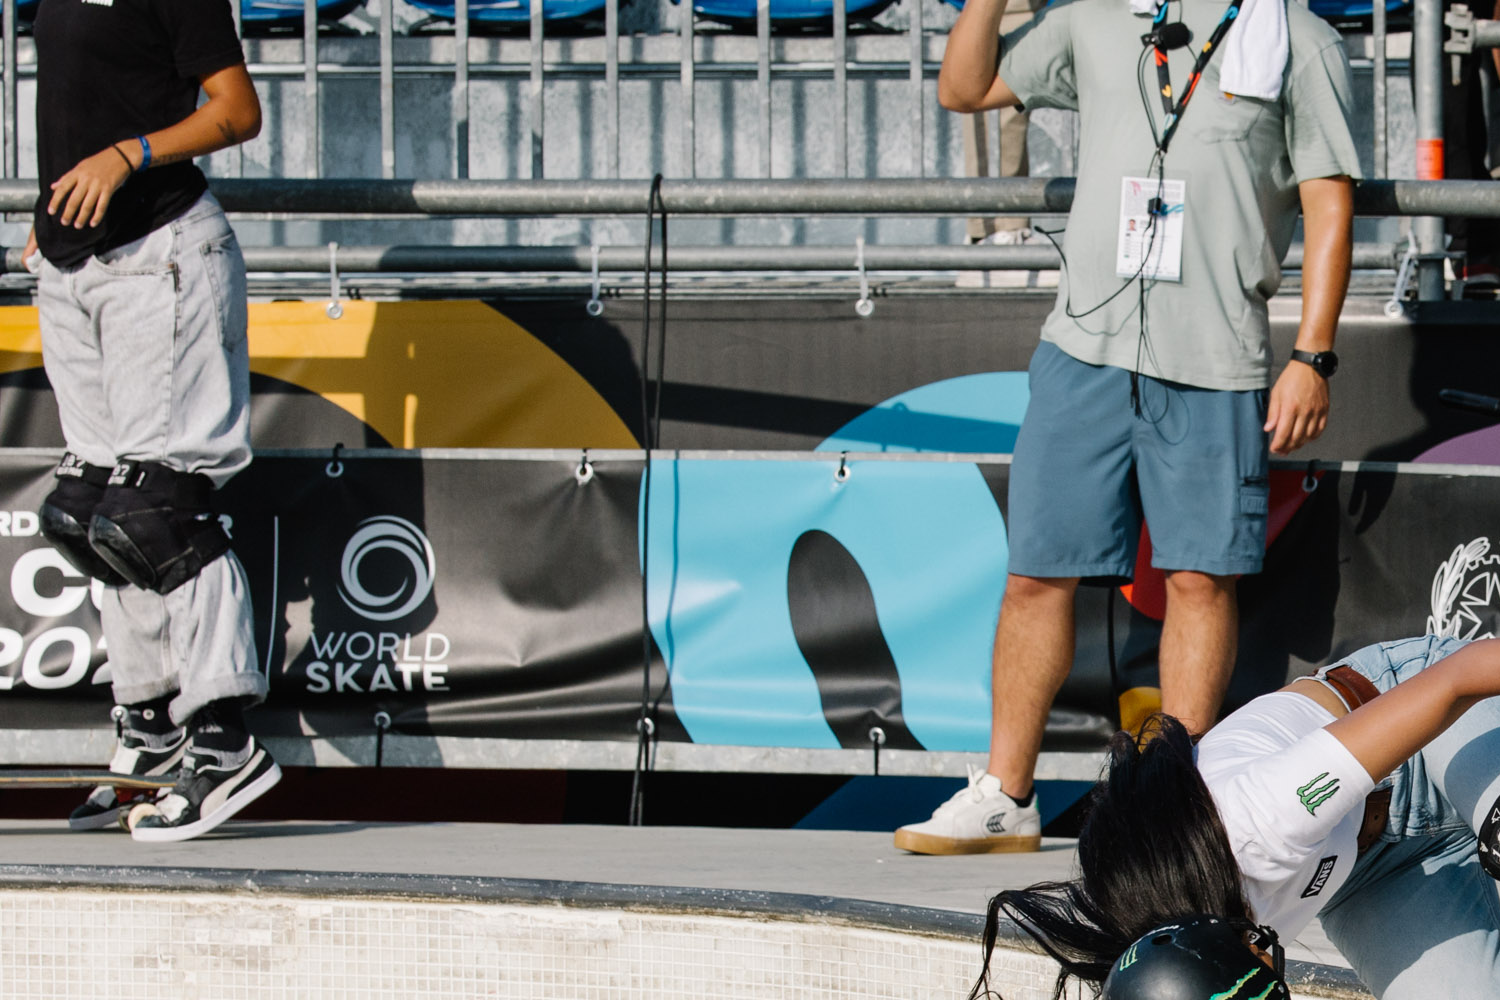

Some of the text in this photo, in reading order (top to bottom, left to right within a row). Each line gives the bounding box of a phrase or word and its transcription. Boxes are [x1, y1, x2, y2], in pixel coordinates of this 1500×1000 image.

[310, 631, 451, 663] WORLD
[305, 660, 451, 694] SKATE
[1305, 860, 1334, 896] VANS
